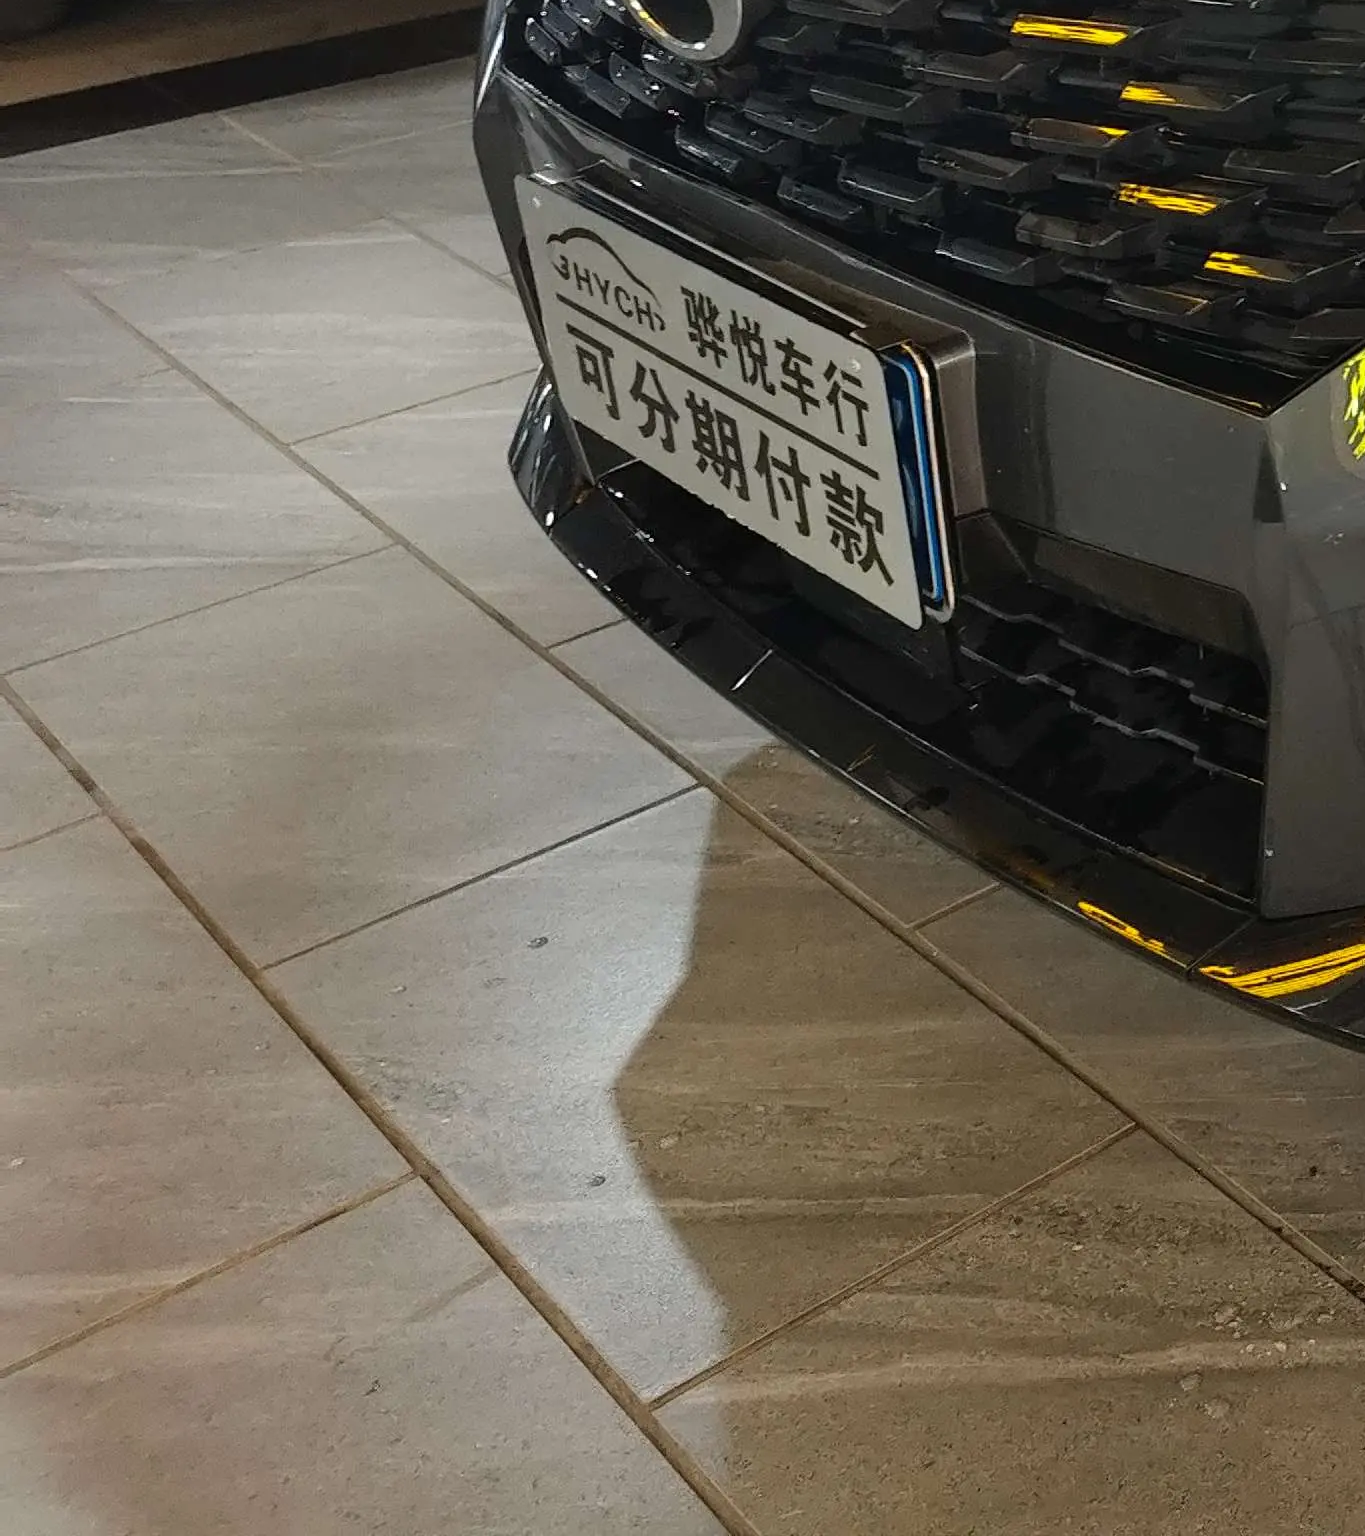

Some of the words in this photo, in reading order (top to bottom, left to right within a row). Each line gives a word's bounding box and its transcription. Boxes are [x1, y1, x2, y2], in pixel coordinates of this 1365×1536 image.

[567, 323, 895, 586] 可分期付款
[681, 285, 870, 447] 骅悦车行
